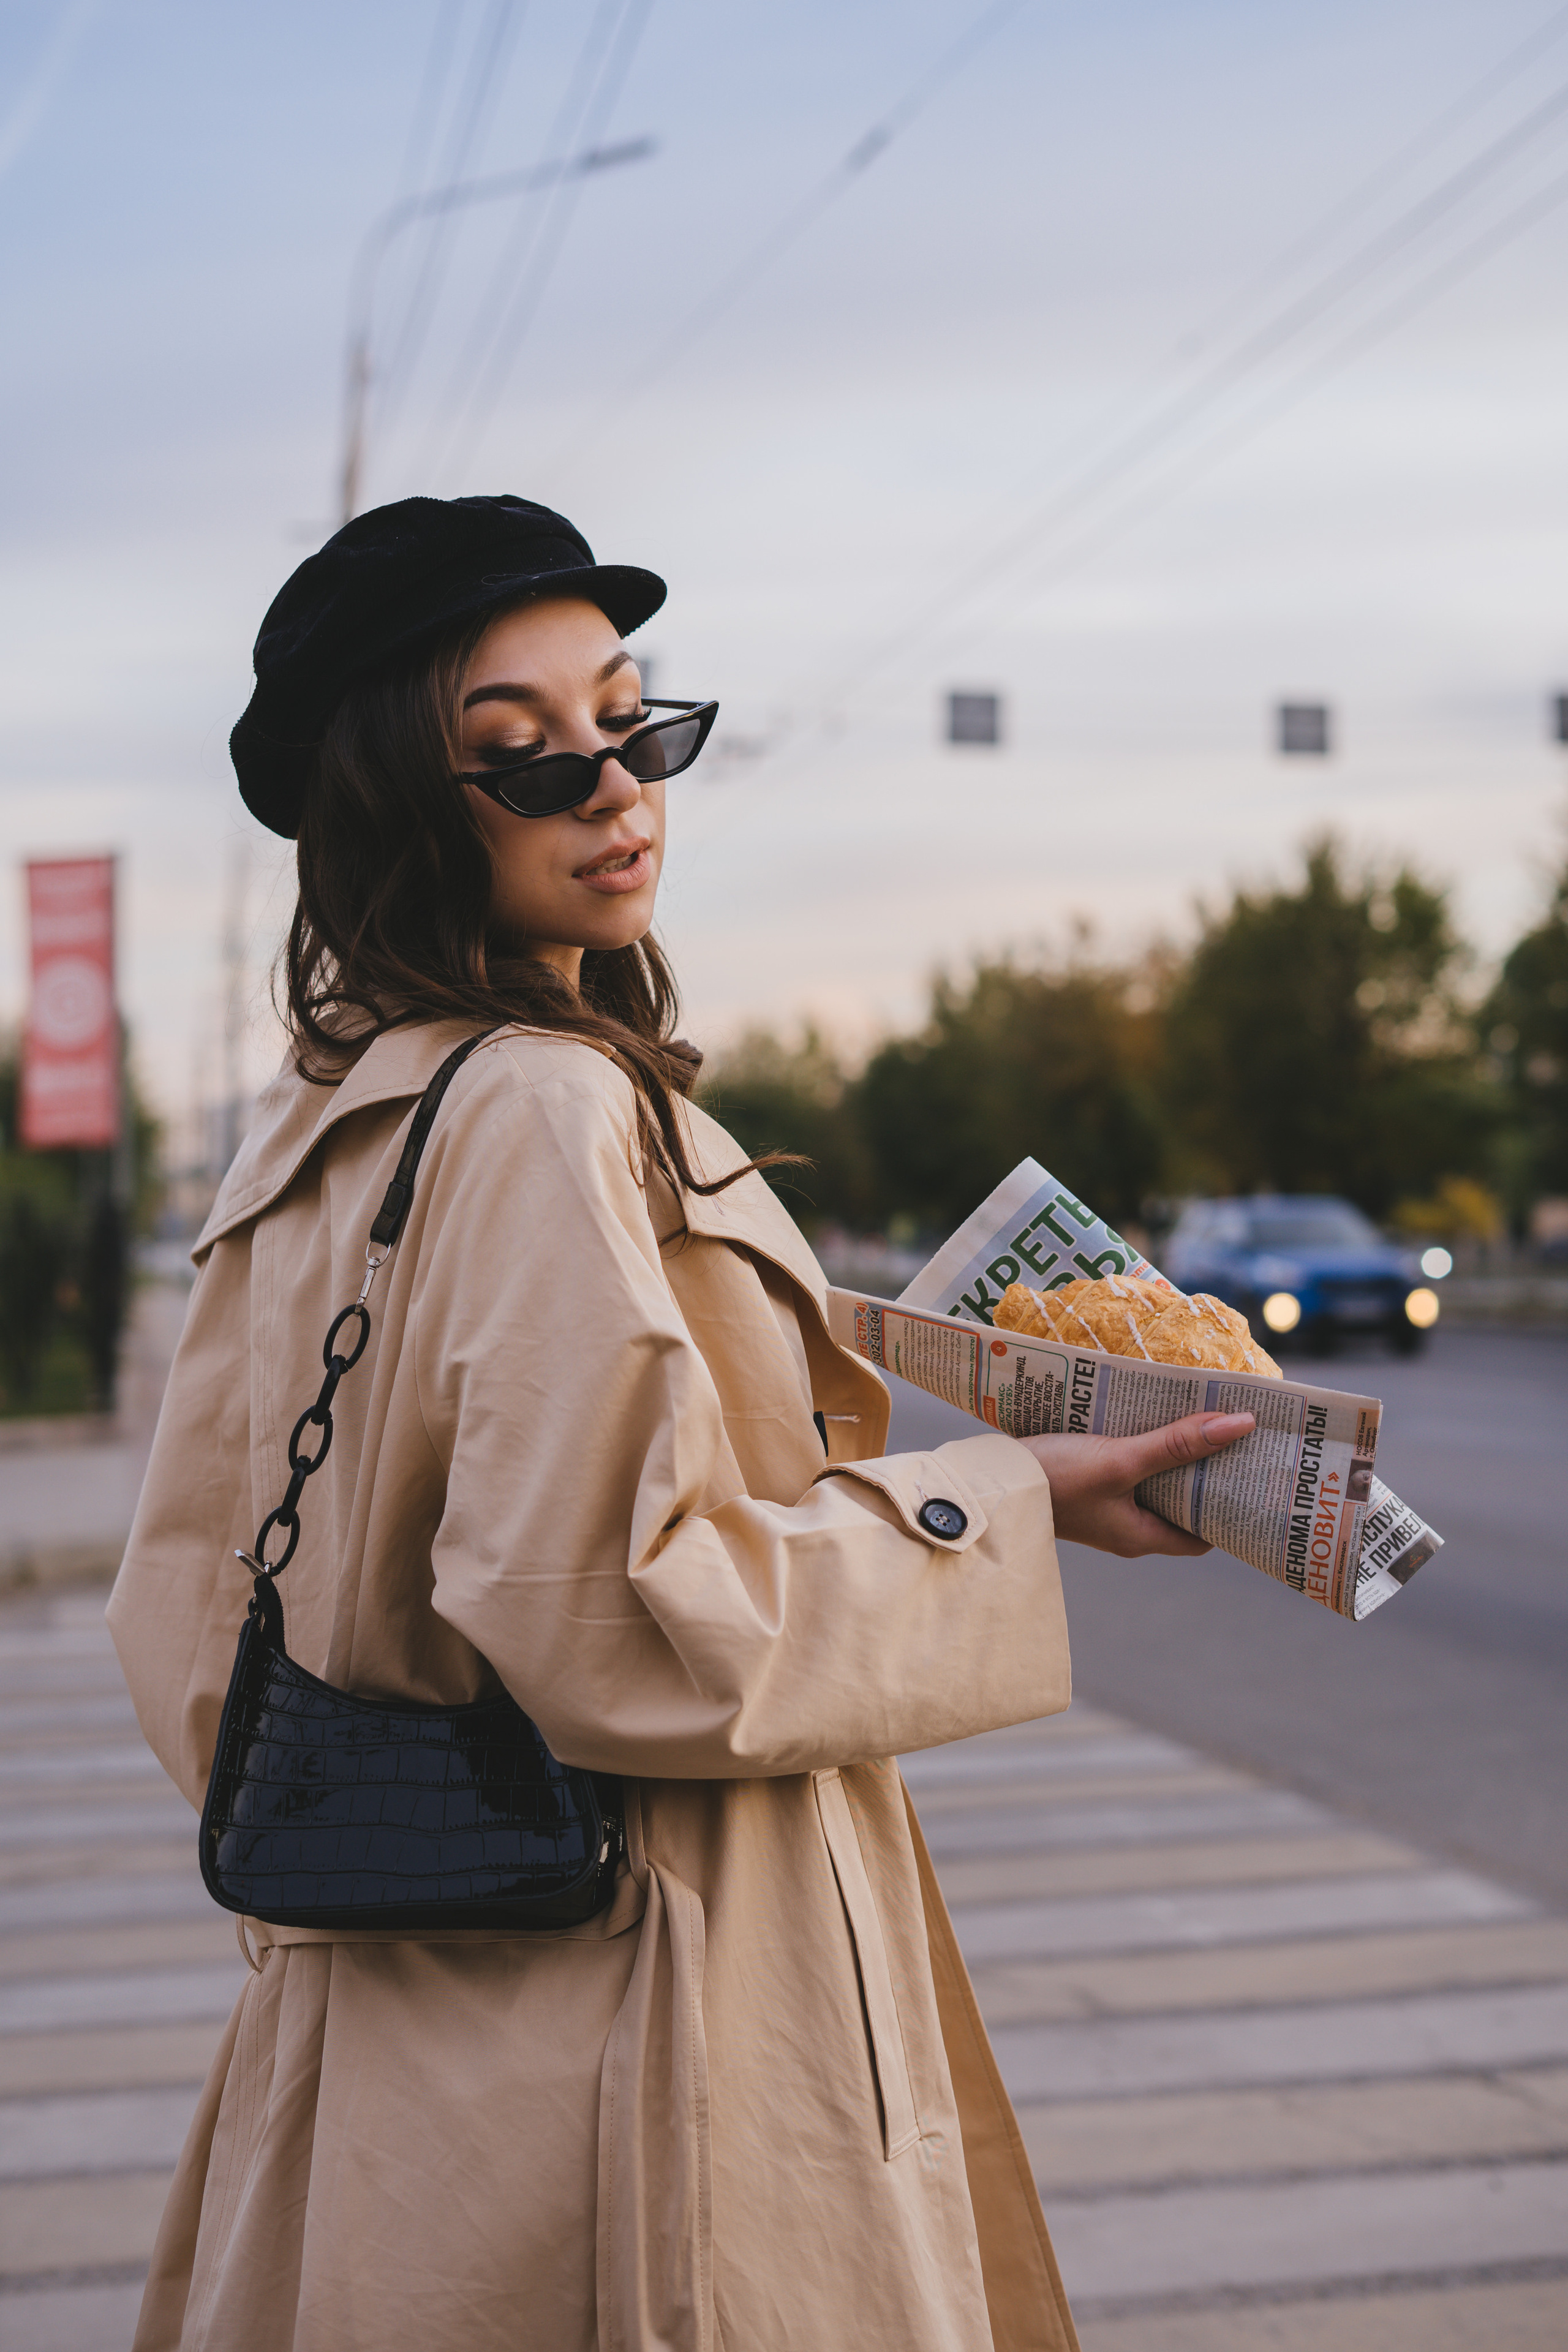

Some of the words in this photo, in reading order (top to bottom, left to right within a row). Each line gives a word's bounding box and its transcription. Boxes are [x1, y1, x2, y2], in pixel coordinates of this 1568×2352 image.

[856, 1302, 867, 1313] 4)
[858, 1317, 867, 1340] СТР.
[870, 1310, 881, 1364] -302-03-04
[1023, 1376, 1034, 1404] СКАТОВ,
[1033, 1381, 1044, 1420] ОТКРЫТИЕ,
[1043, 1371, 1054, 1402] ВОССТА-
[1052, 1380, 1063, 1415] СУСТАВЫ
[1268, 1428, 1278, 1457] Благодаря
[1273, 1393, 1283, 1427] «Аденовиту»
[1255, 1427, 1265, 1466] расстраивало,
[1294, 1404, 1327, 1509] ПРОСТАТЫ!
[1362, 1427, 1371, 1457] Артемович,
[1194, 1478, 1203, 1508] Борисовна,
[1210, 1472, 1219, 1502] Первый-то
[1248, 1484, 1256, 1505] больше
[1245, 1507, 1254, 1522] Мишу
[1253, 1494, 1262, 1517] Поэтому
[1272, 1496, 1281, 1529] наладилась,
[1338, 1540, 1346, 1574] Кисловодск
